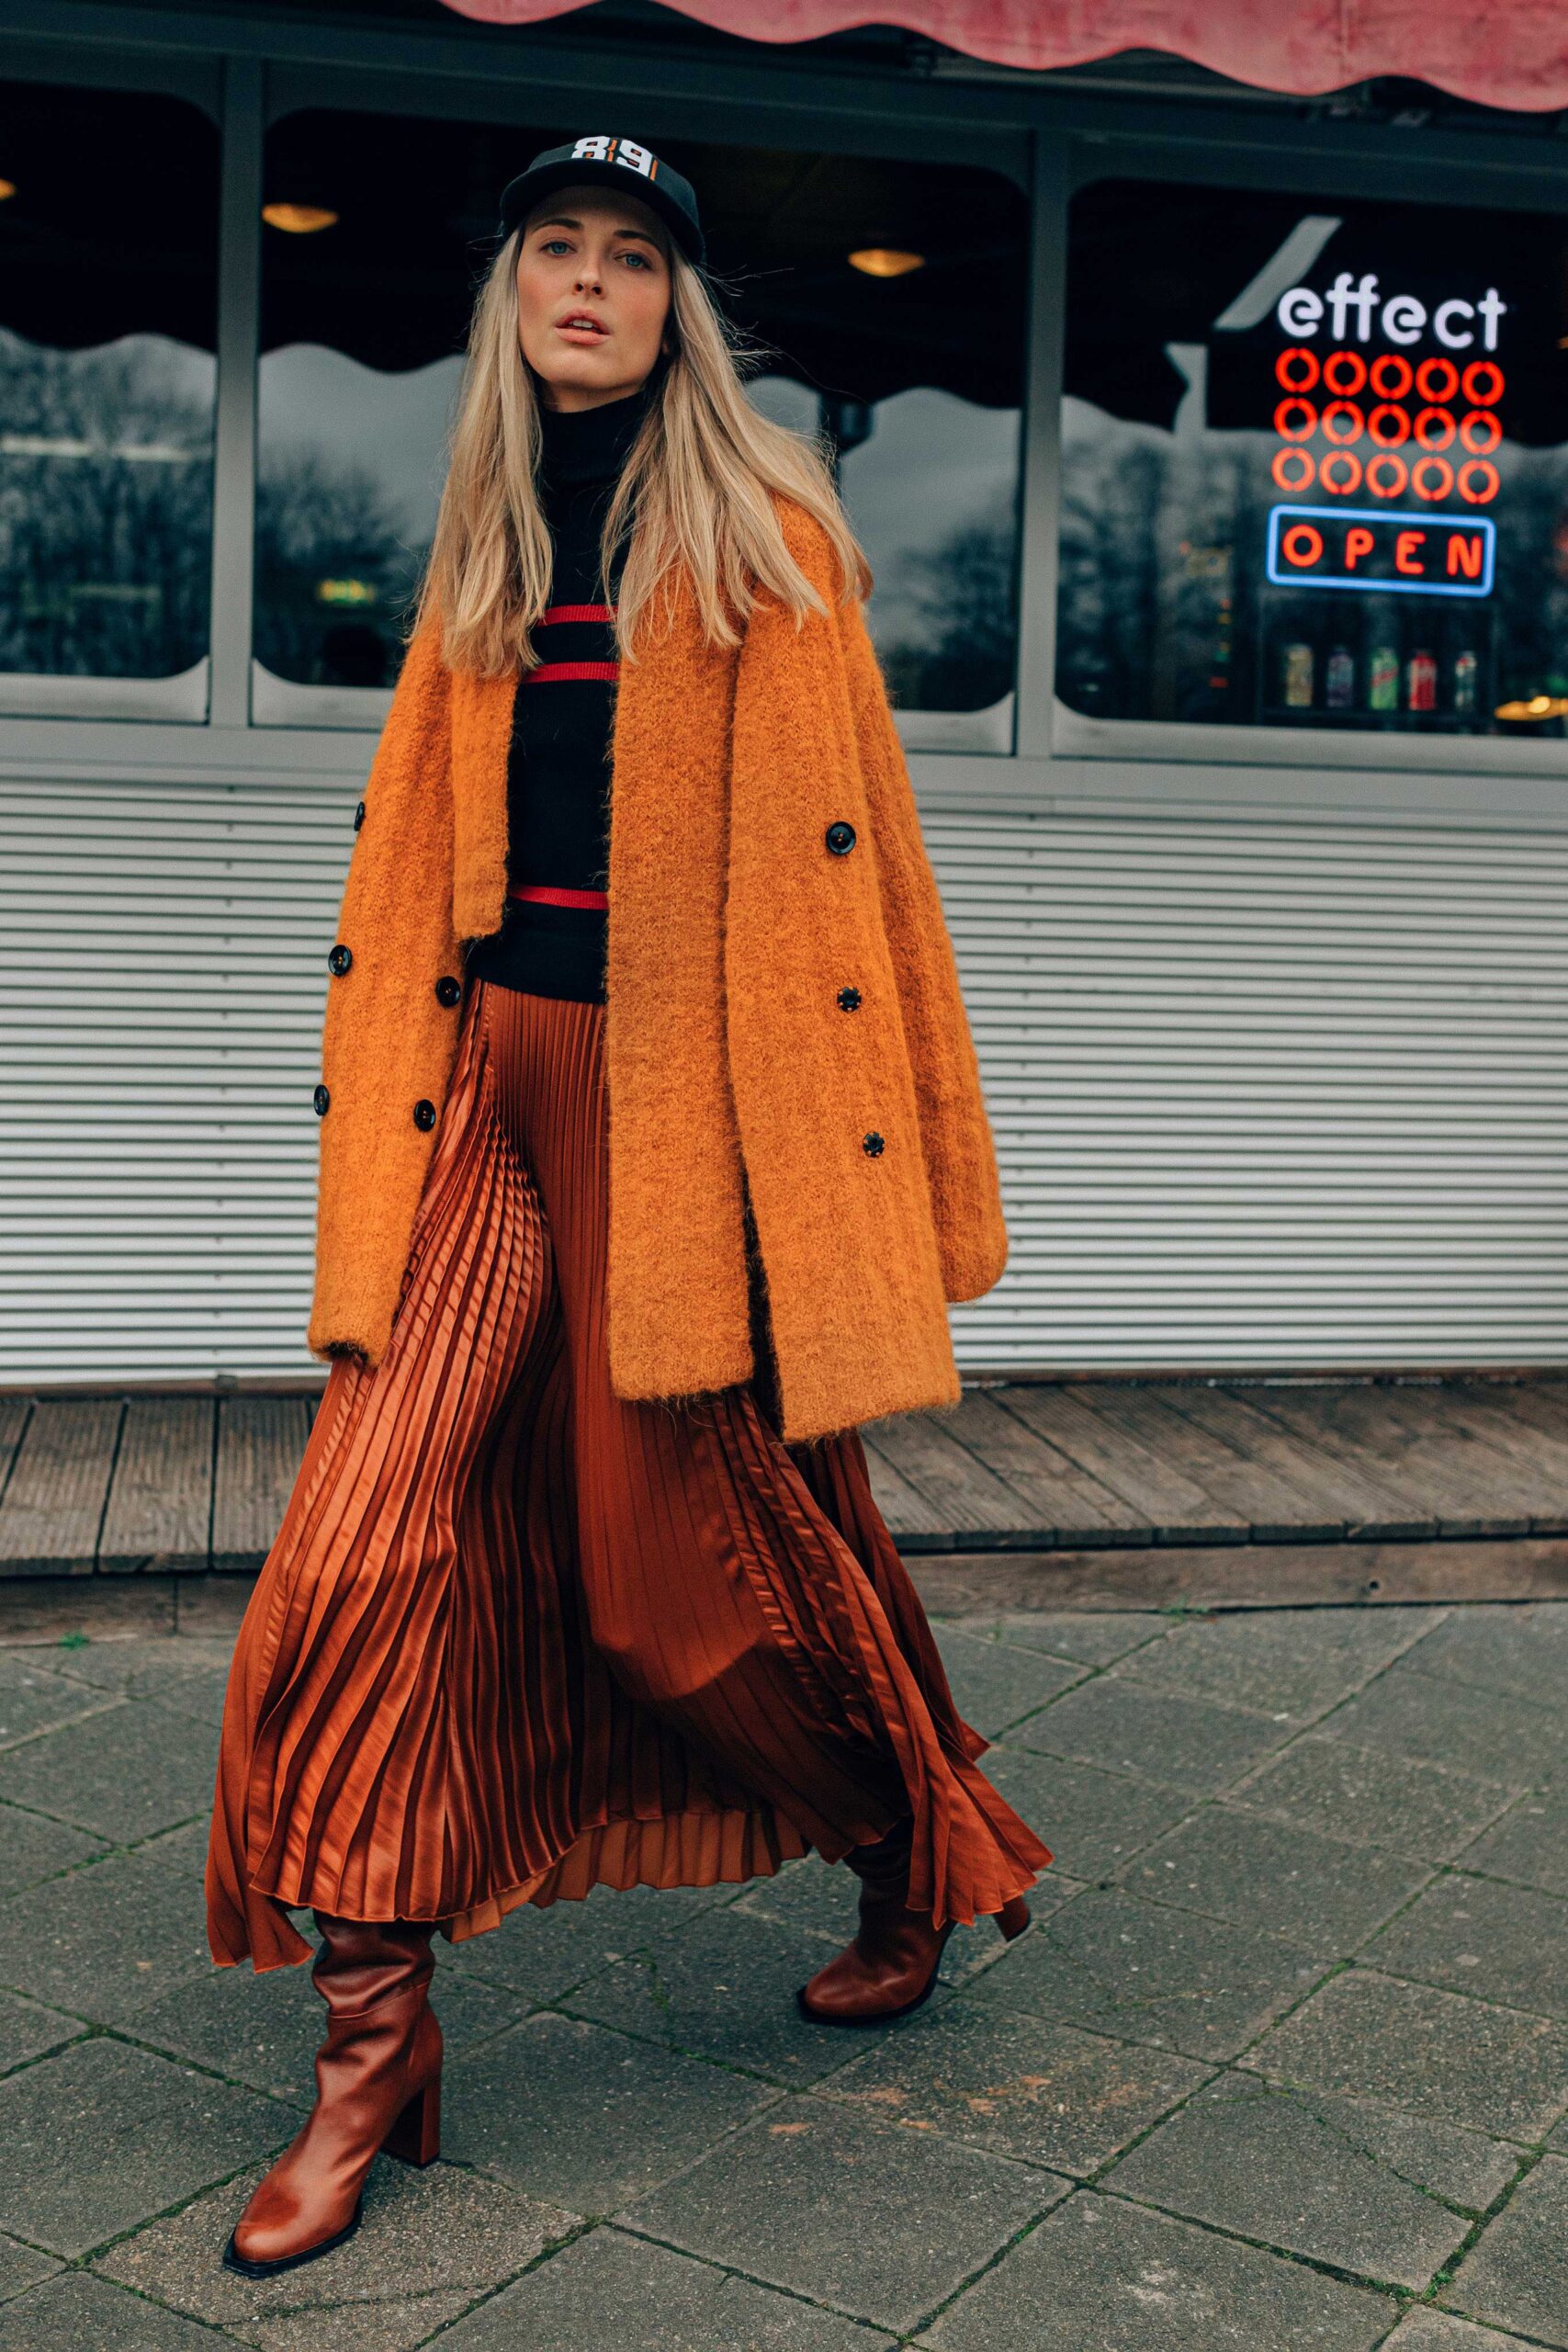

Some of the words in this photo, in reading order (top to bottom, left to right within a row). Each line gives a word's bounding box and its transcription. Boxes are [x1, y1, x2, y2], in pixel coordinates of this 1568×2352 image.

[570, 135, 653, 177] 89
[1278, 273, 1507, 352] effect
[1282, 524, 1483, 578] OPEN
